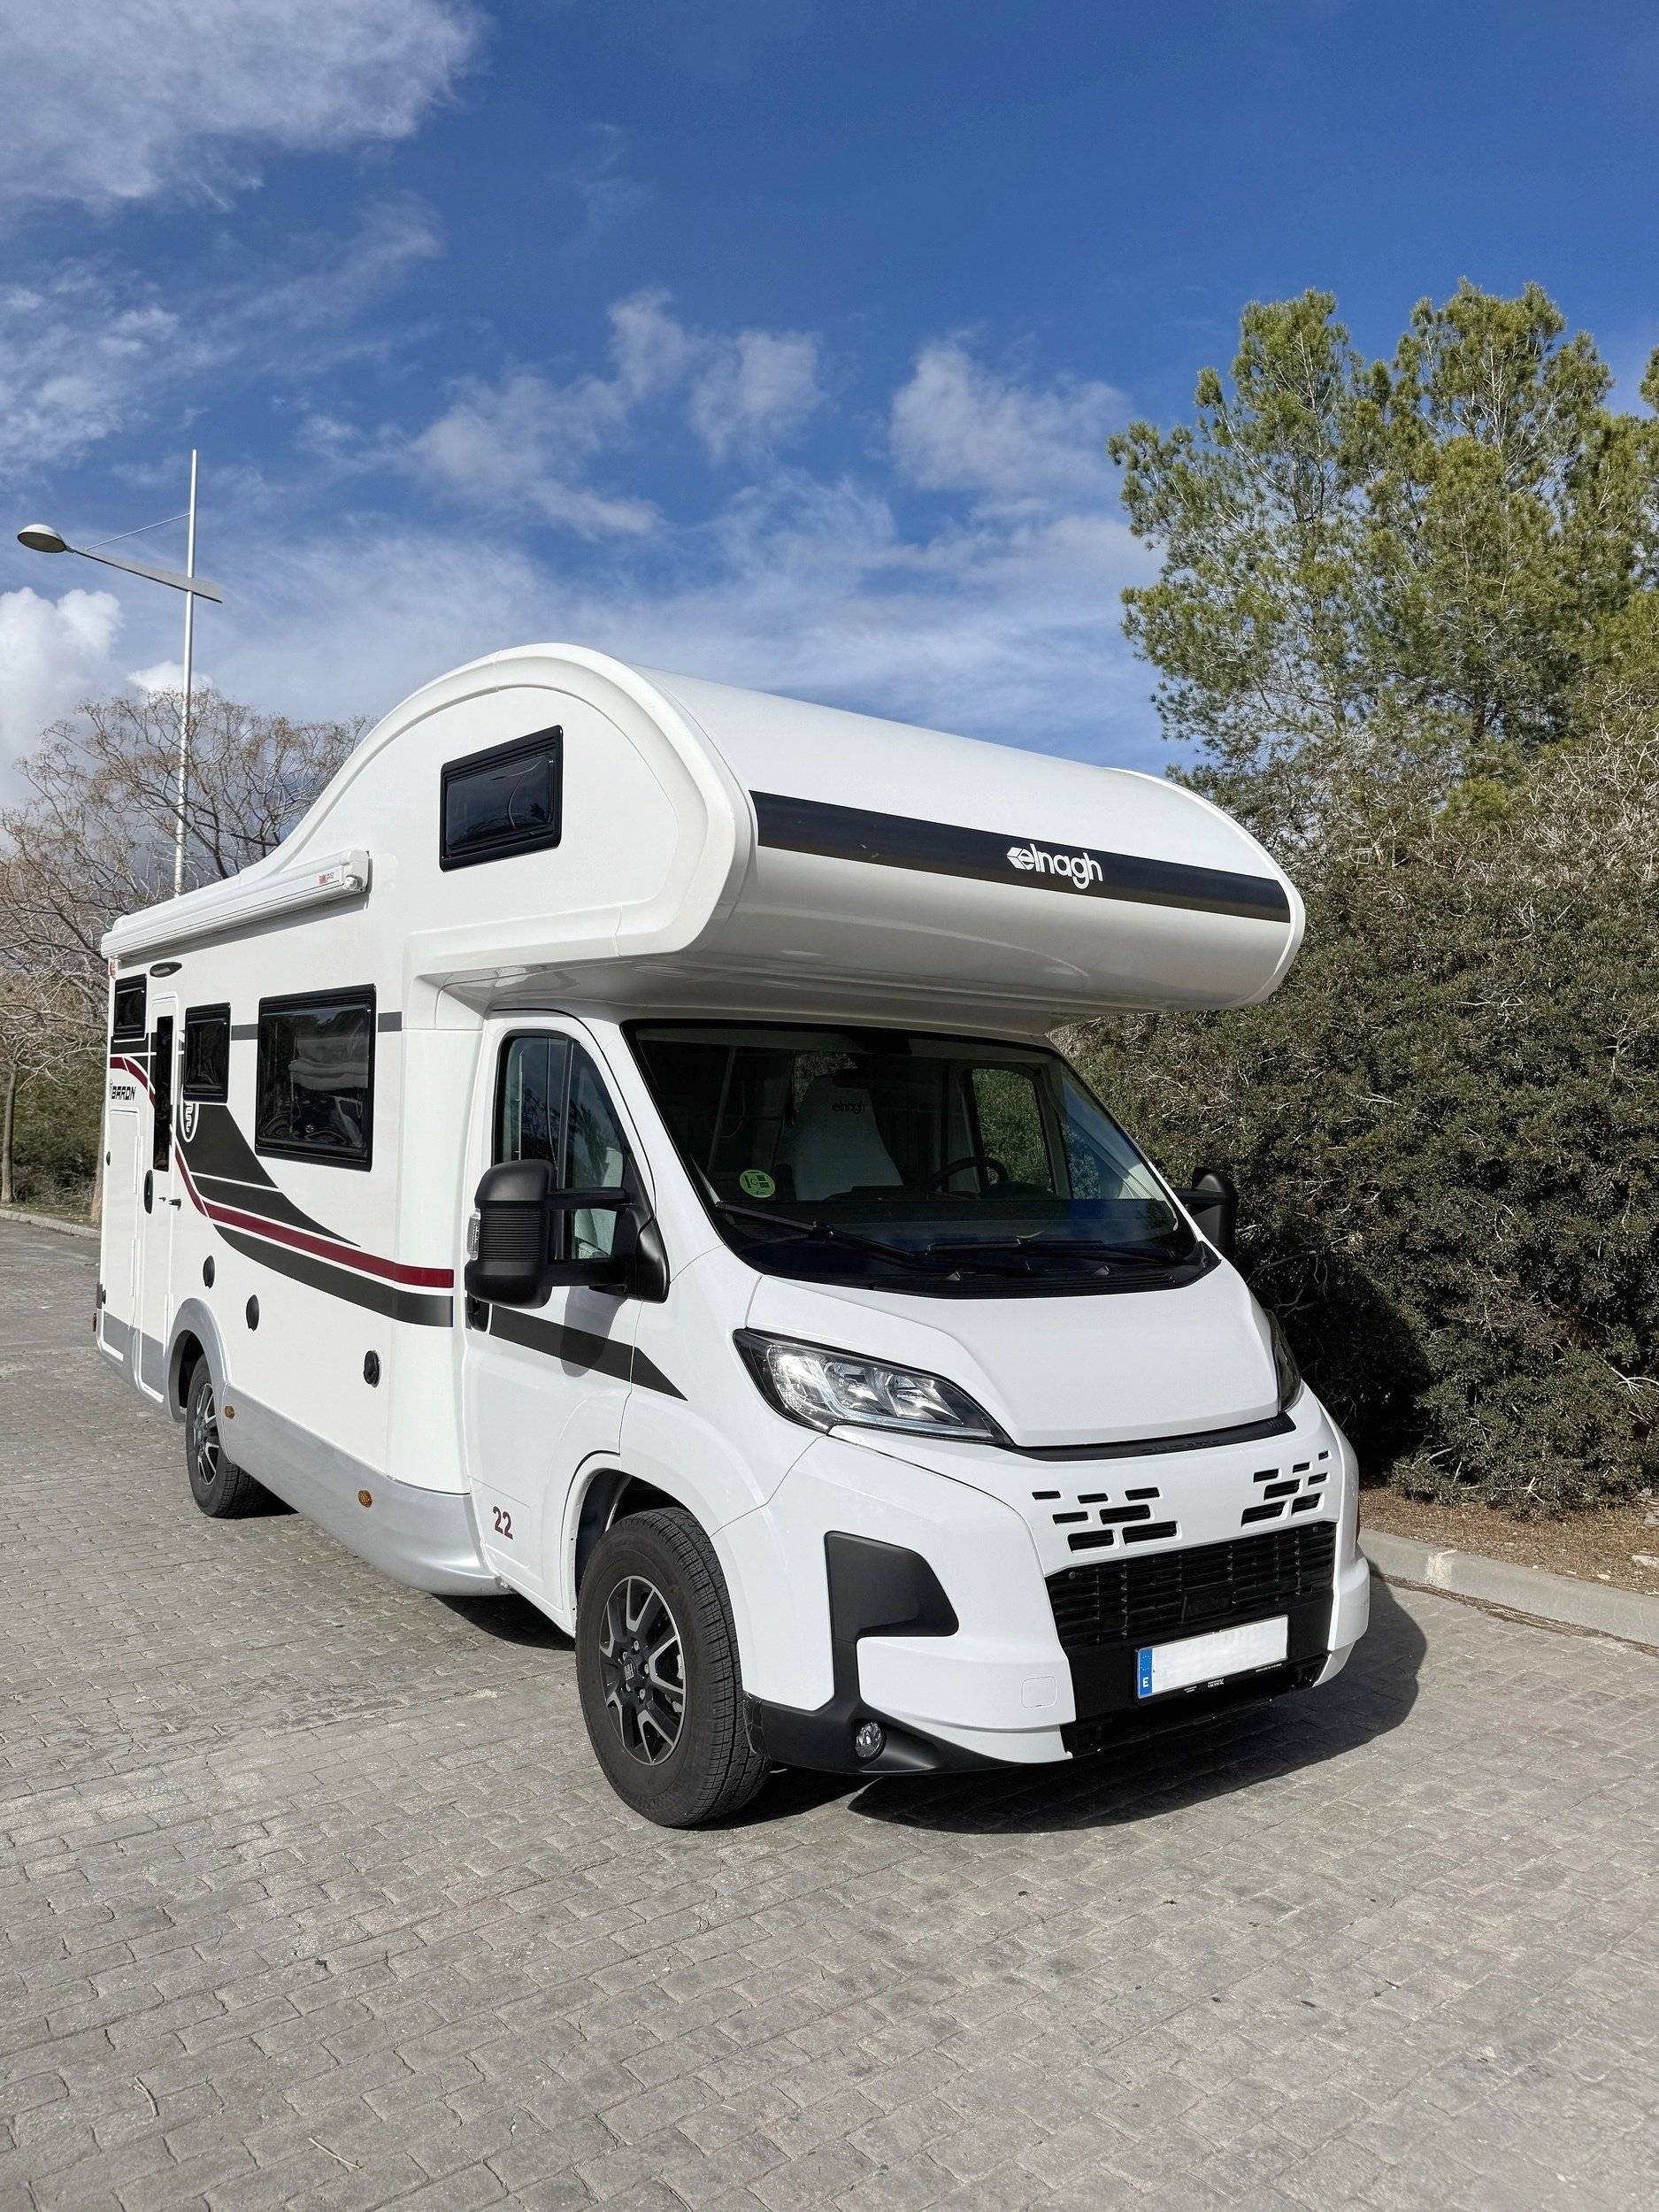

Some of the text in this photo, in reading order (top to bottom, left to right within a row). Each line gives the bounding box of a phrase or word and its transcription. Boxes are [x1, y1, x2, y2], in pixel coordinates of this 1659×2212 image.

[1006, 843, 1103, 889] elnagh
[111, 1086, 136, 1101] BARON
[492, 1505, 514, 1540] 22
[1142, 1676, 1149, 1688] E
